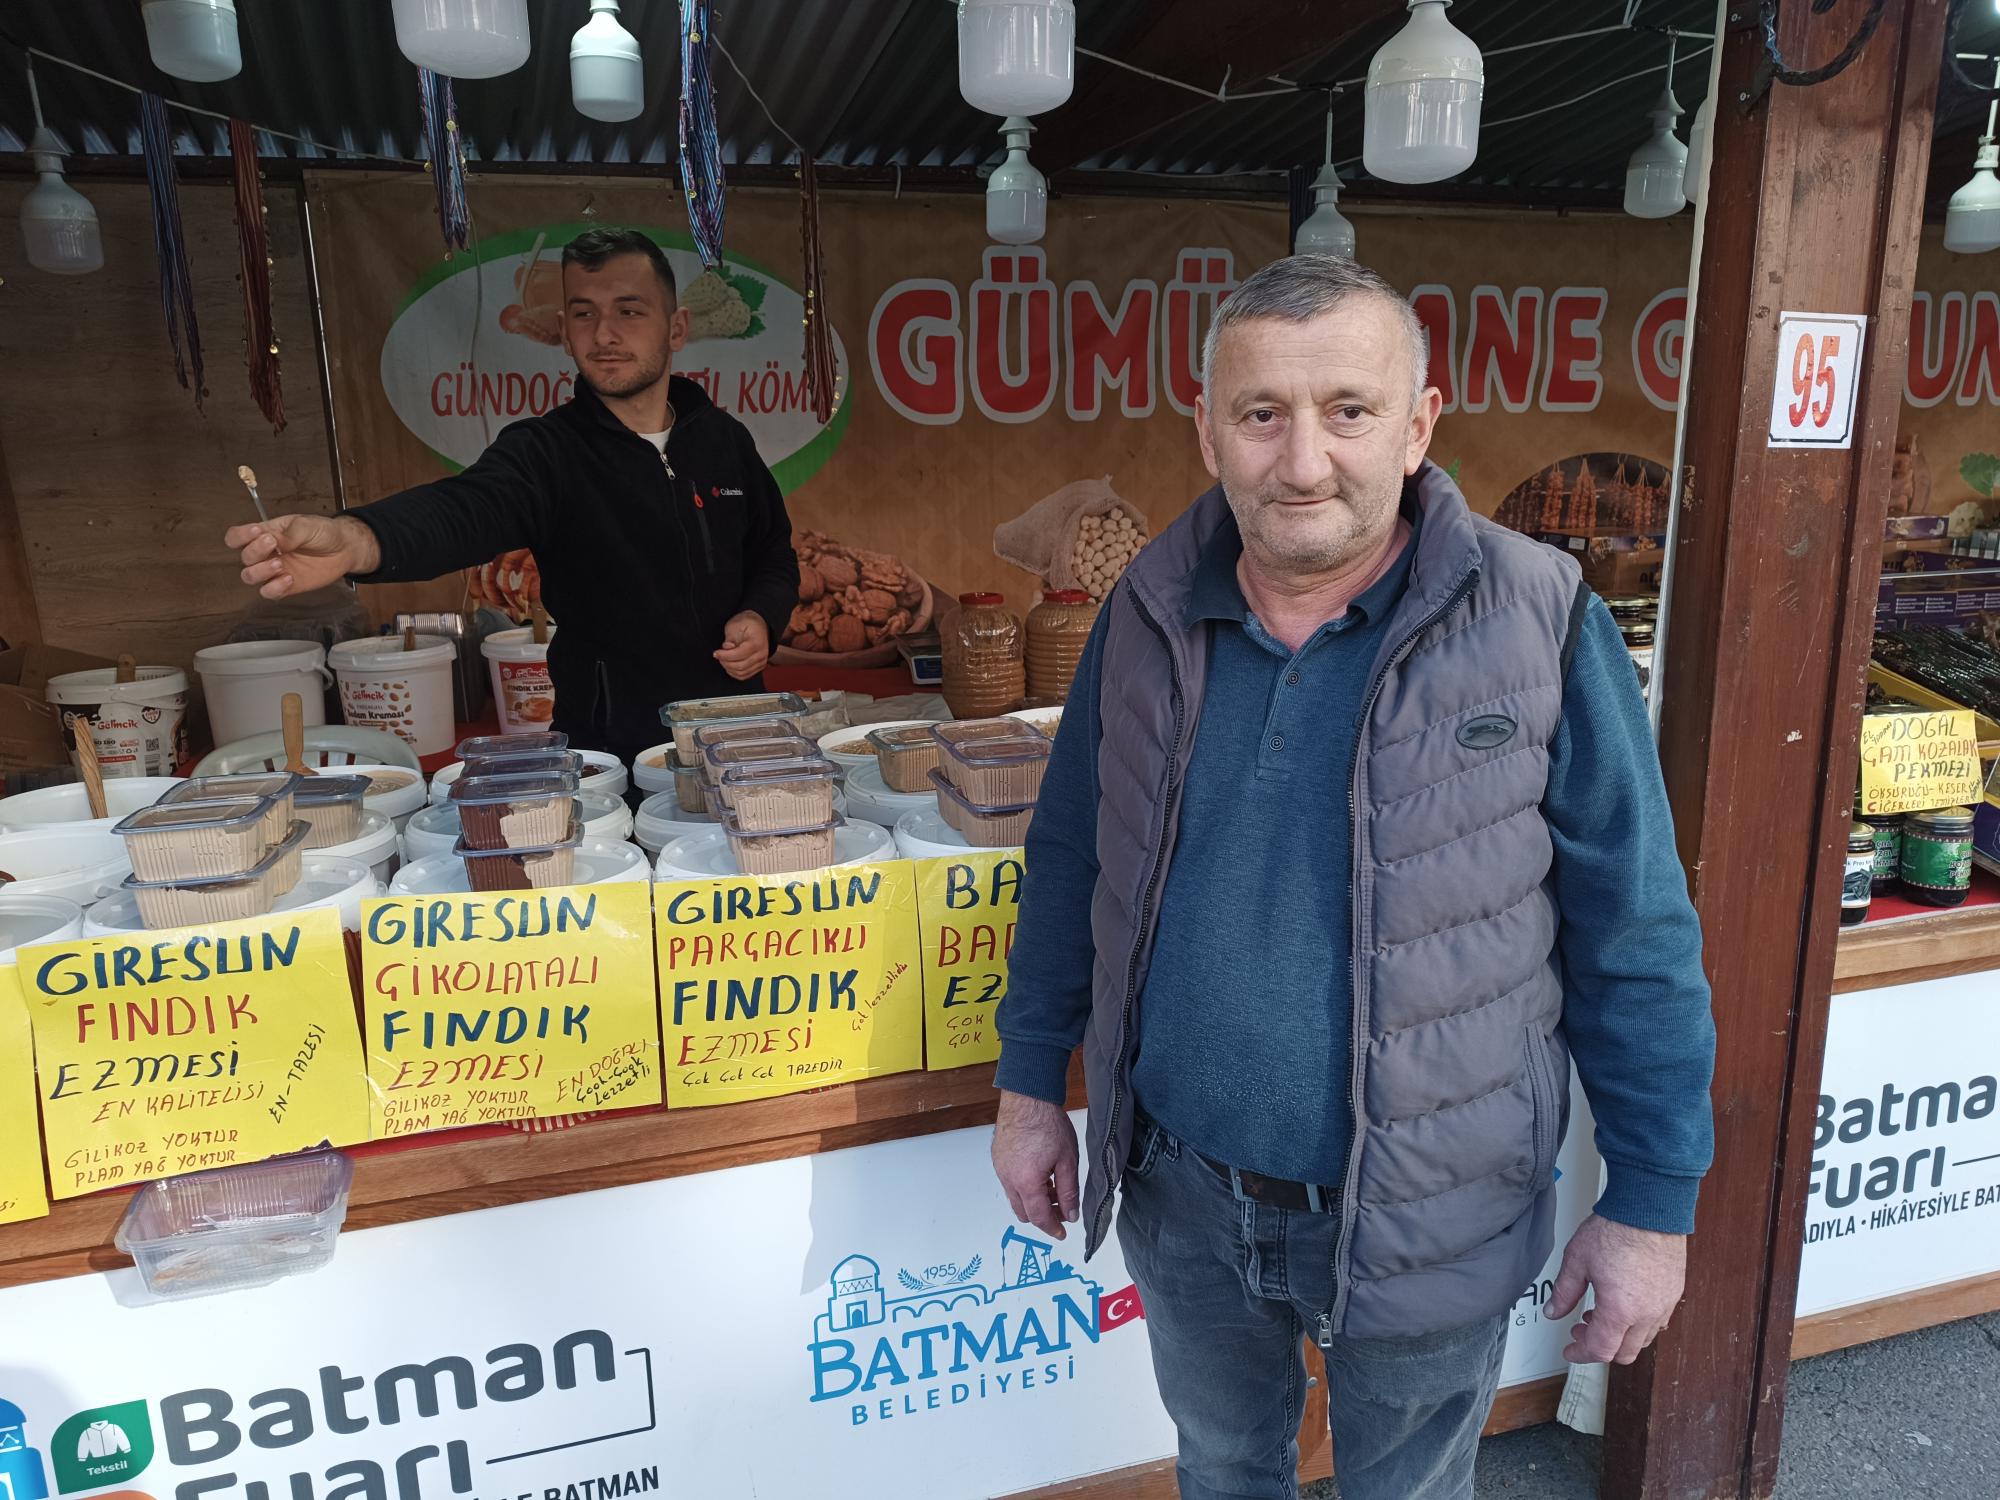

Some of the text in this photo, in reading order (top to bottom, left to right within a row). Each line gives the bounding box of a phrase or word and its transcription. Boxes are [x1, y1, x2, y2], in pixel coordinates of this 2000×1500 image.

[868, 245, 1608, 426] GÜMÜANE
[431, 362, 576, 417] GÜNDOĞ
[737, 361, 824, 414] KÖM
[1788, 333, 1841, 428] 95
[1892, 713, 1960, 741] DOĞAL
[1862, 737, 1978, 767] ÇAM KOZALAK
[1894, 758, 1972, 783] PEKMEZİ
[368, 893, 597, 948] GİRESUN
[667, 872, 881, 925] GİRESUN
[36, 926, 301, 996] GİRESUN
[669, 924, 867, 970] PARÇACIKLI
[375, 956, 598, 1001] ÇİKOLATALI
[673, 968, 859, 1026] FINDIK
[77, 994, 258, 1044] FINDIK
[383, 1005, 591, 1052] FINDIK
[677, 1018, 813, 1067] EZMESİ
[49, 1040, 240, 1100] EZMESİ
[387, 1048, 544, 1091] EZMESİ
[786, 1056, 843, 1077] TAZEDİR
[92, 1081, 265, 1124] EN KALİTELİSİ
[384, 1090, 528, 1117] GİLİKOZ YOKTUR
[384, 1105, 537, 1136] PLAM YAĞ YOKTUR
[64, 1129, 239, 1168] GİLİKOZ YOKTUR
[75, 1149, 236, 1188] PLAM YAĞ YOKTUR
[1870, 1190, 1971, 1231] HİKÂYESİYLE
[924, 1263, 957, 1280] 1955
[807, 1286, 1103, 1402] BATMAN
[160, 1329, 617, 1466] Batman
[851, 1355, 1075, 1426] BELEDİYESİ
[87, 1460, 128, 1476] Tekstil
